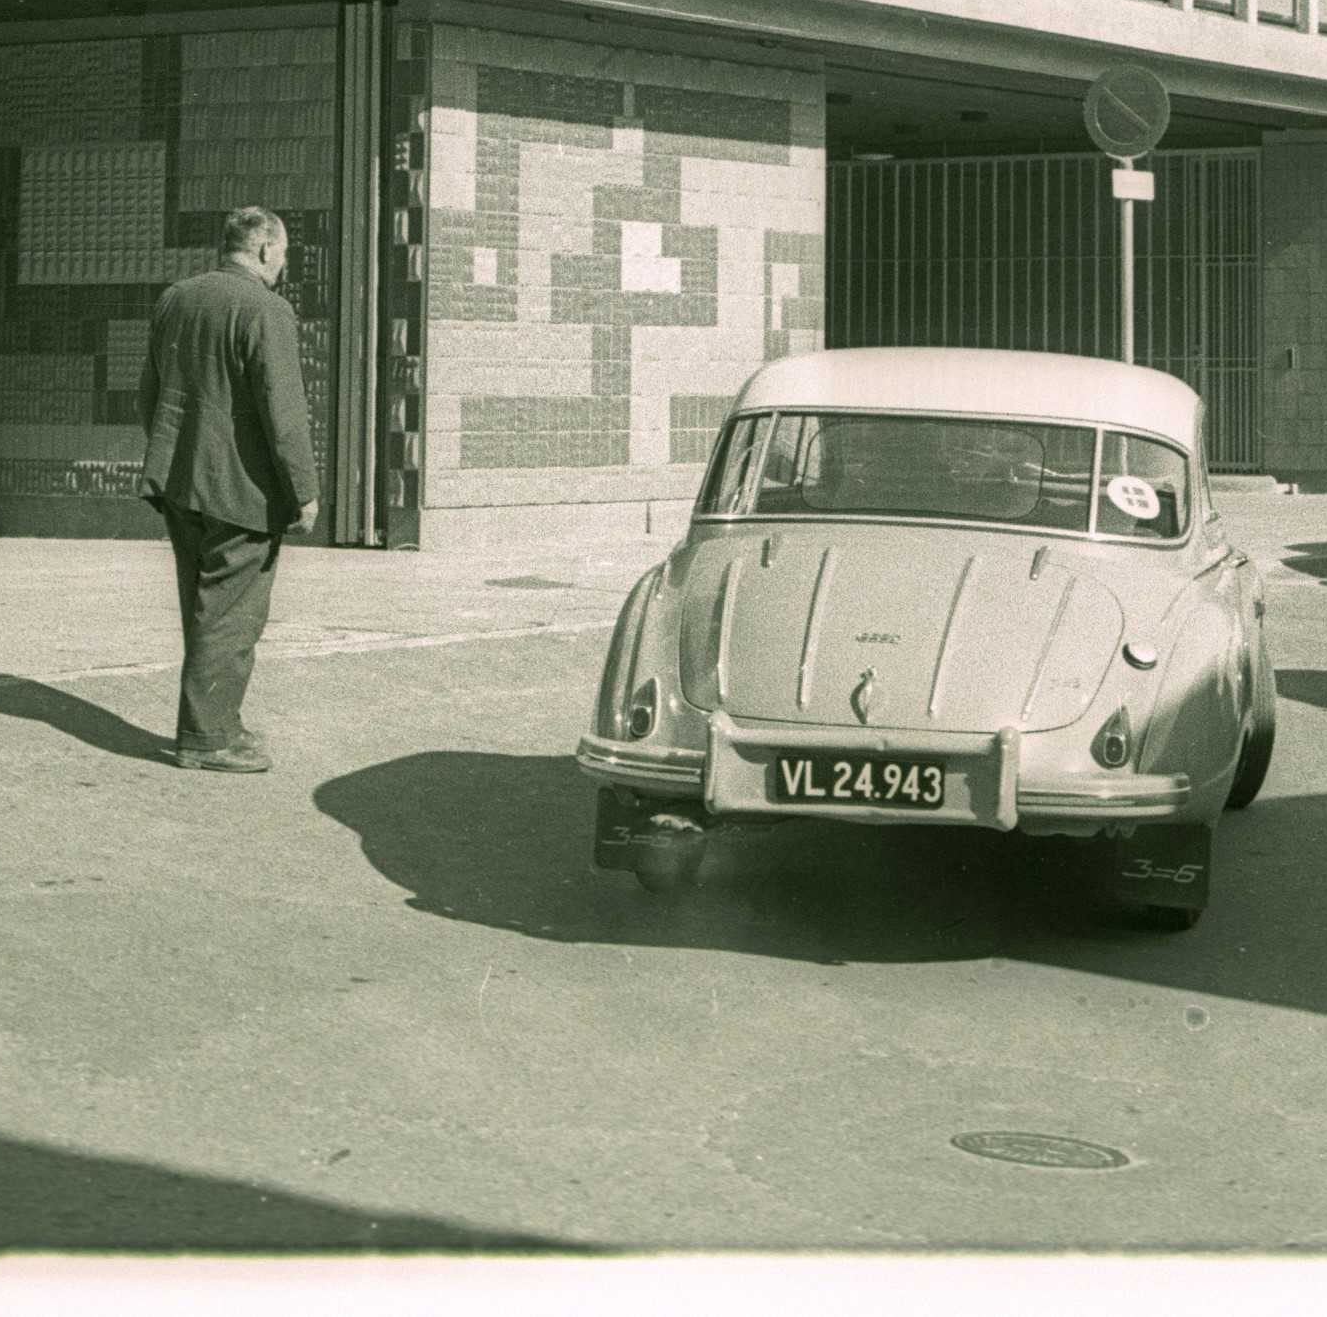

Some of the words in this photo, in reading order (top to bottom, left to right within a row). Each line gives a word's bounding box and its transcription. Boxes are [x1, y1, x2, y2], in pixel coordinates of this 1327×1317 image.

[781, 759, 826, 796] VL
[833, 761, 942, 802] 24.943
[1121, 858, 1204, 883] 3=6
